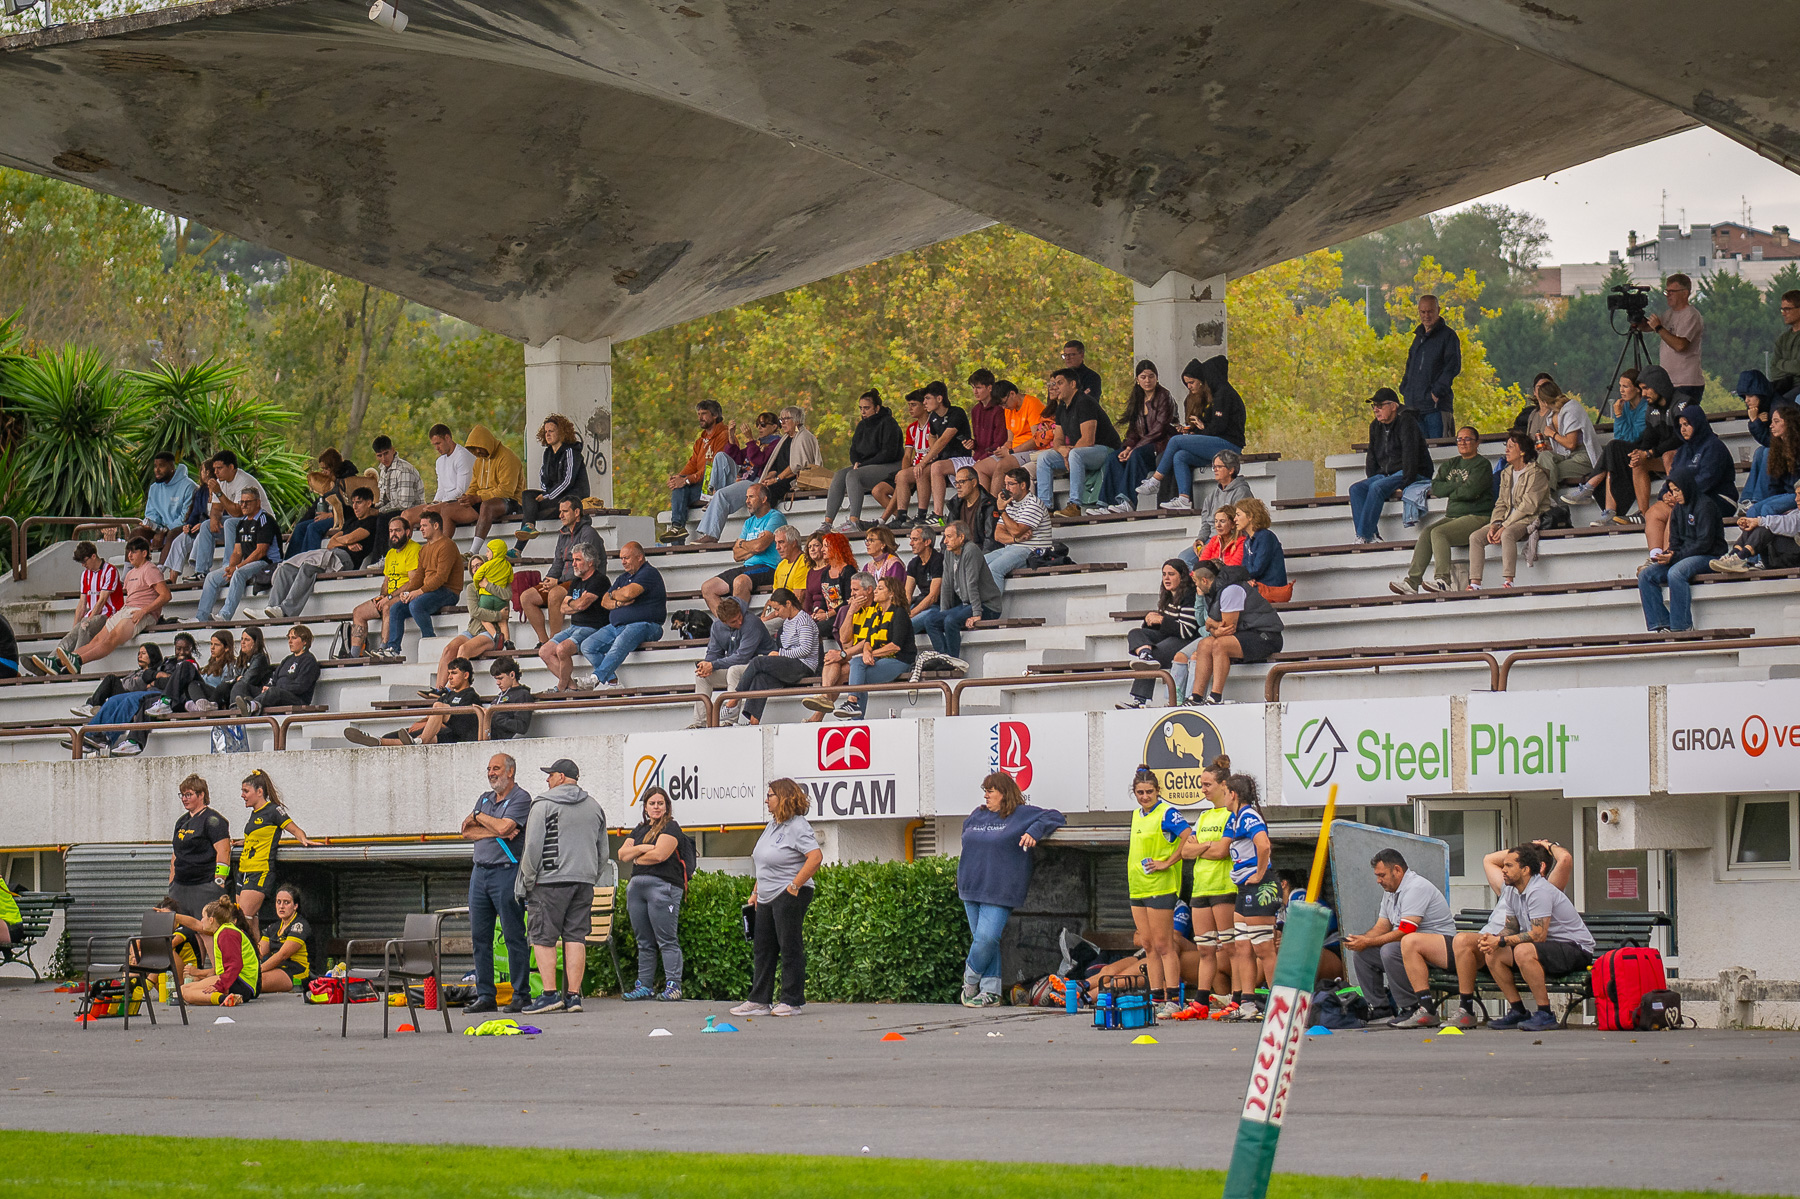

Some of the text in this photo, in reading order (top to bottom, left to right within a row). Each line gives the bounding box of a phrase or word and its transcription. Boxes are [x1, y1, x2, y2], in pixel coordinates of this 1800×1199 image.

[990, 723, 999, 775] ZKAIA
[1356, 728, 1449, 782] Steel
[1470, 721, 1569, 776] Phalt
[1672, 727, 1736, 751] GIROA
[700, 783, 755, 800] FUNDACIÓN
[1168, 791, 1200, 799] ERRUGBIA
[542, 811, 559, 871] PUMA
